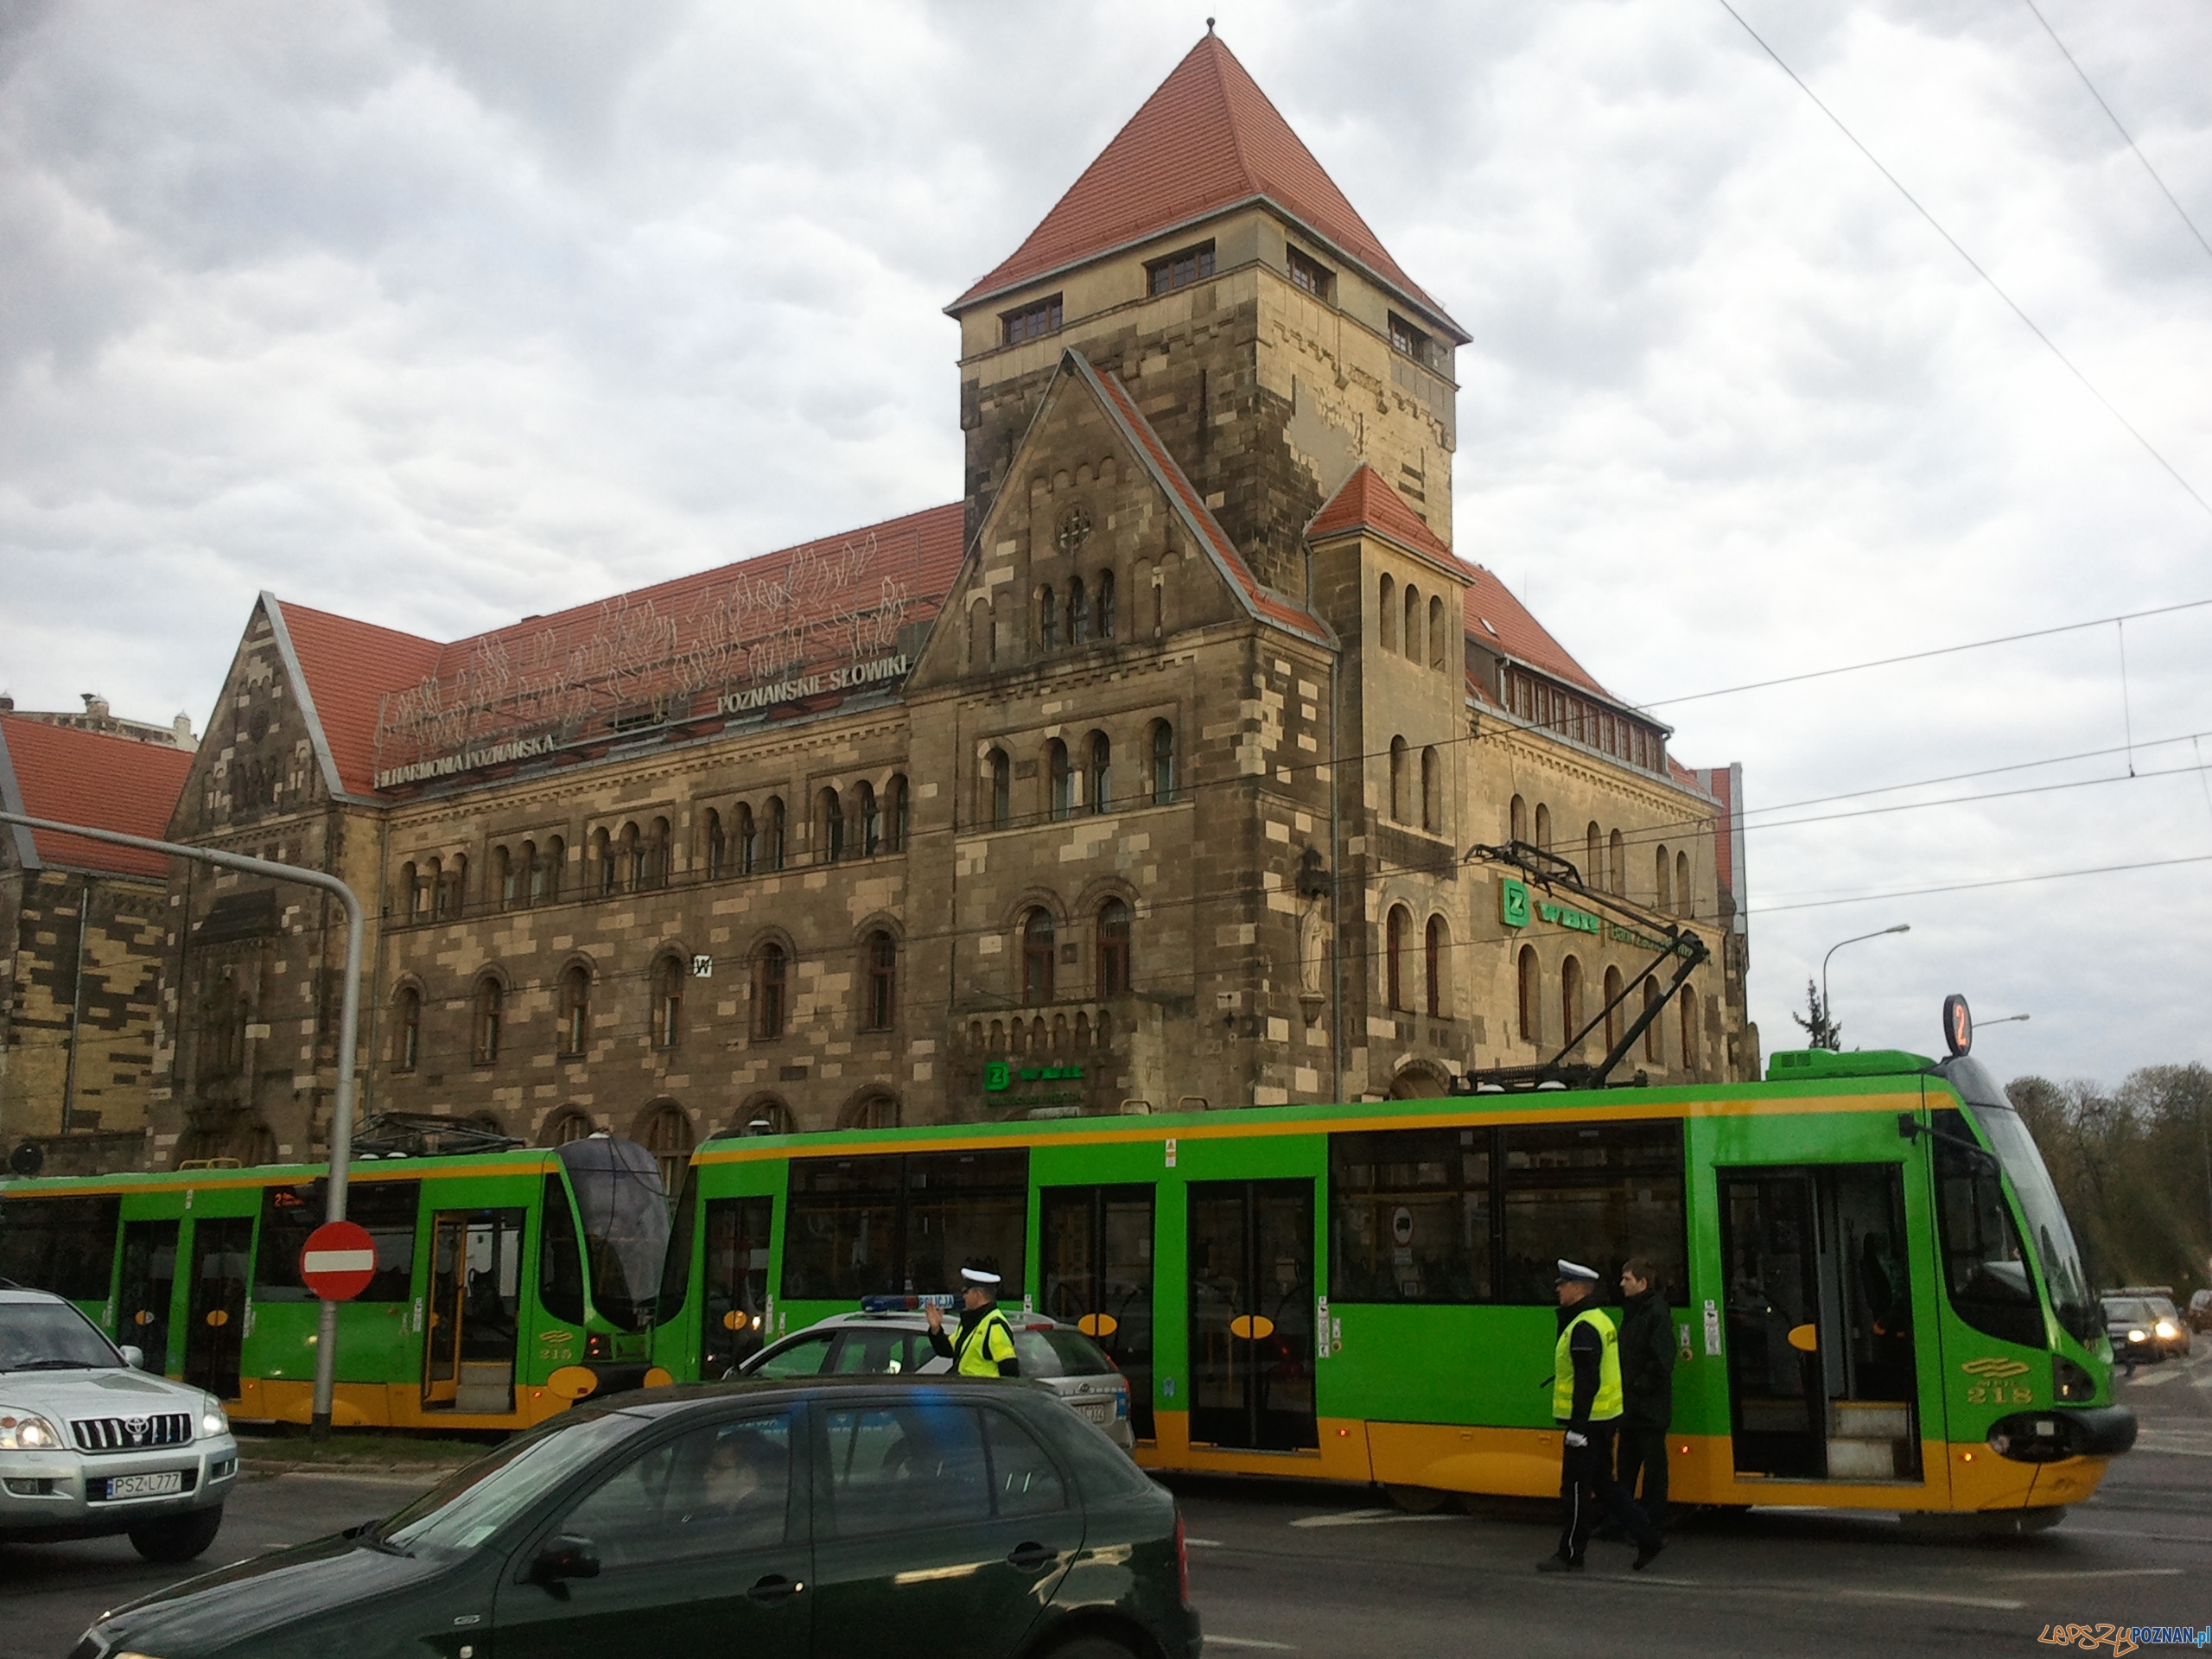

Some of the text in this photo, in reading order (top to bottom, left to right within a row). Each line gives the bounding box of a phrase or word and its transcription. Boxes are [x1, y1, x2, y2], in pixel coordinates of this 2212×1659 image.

[1955, 1005, 1967, 1046] 2
[115, 1473, 180, 1494] PSZ L777
